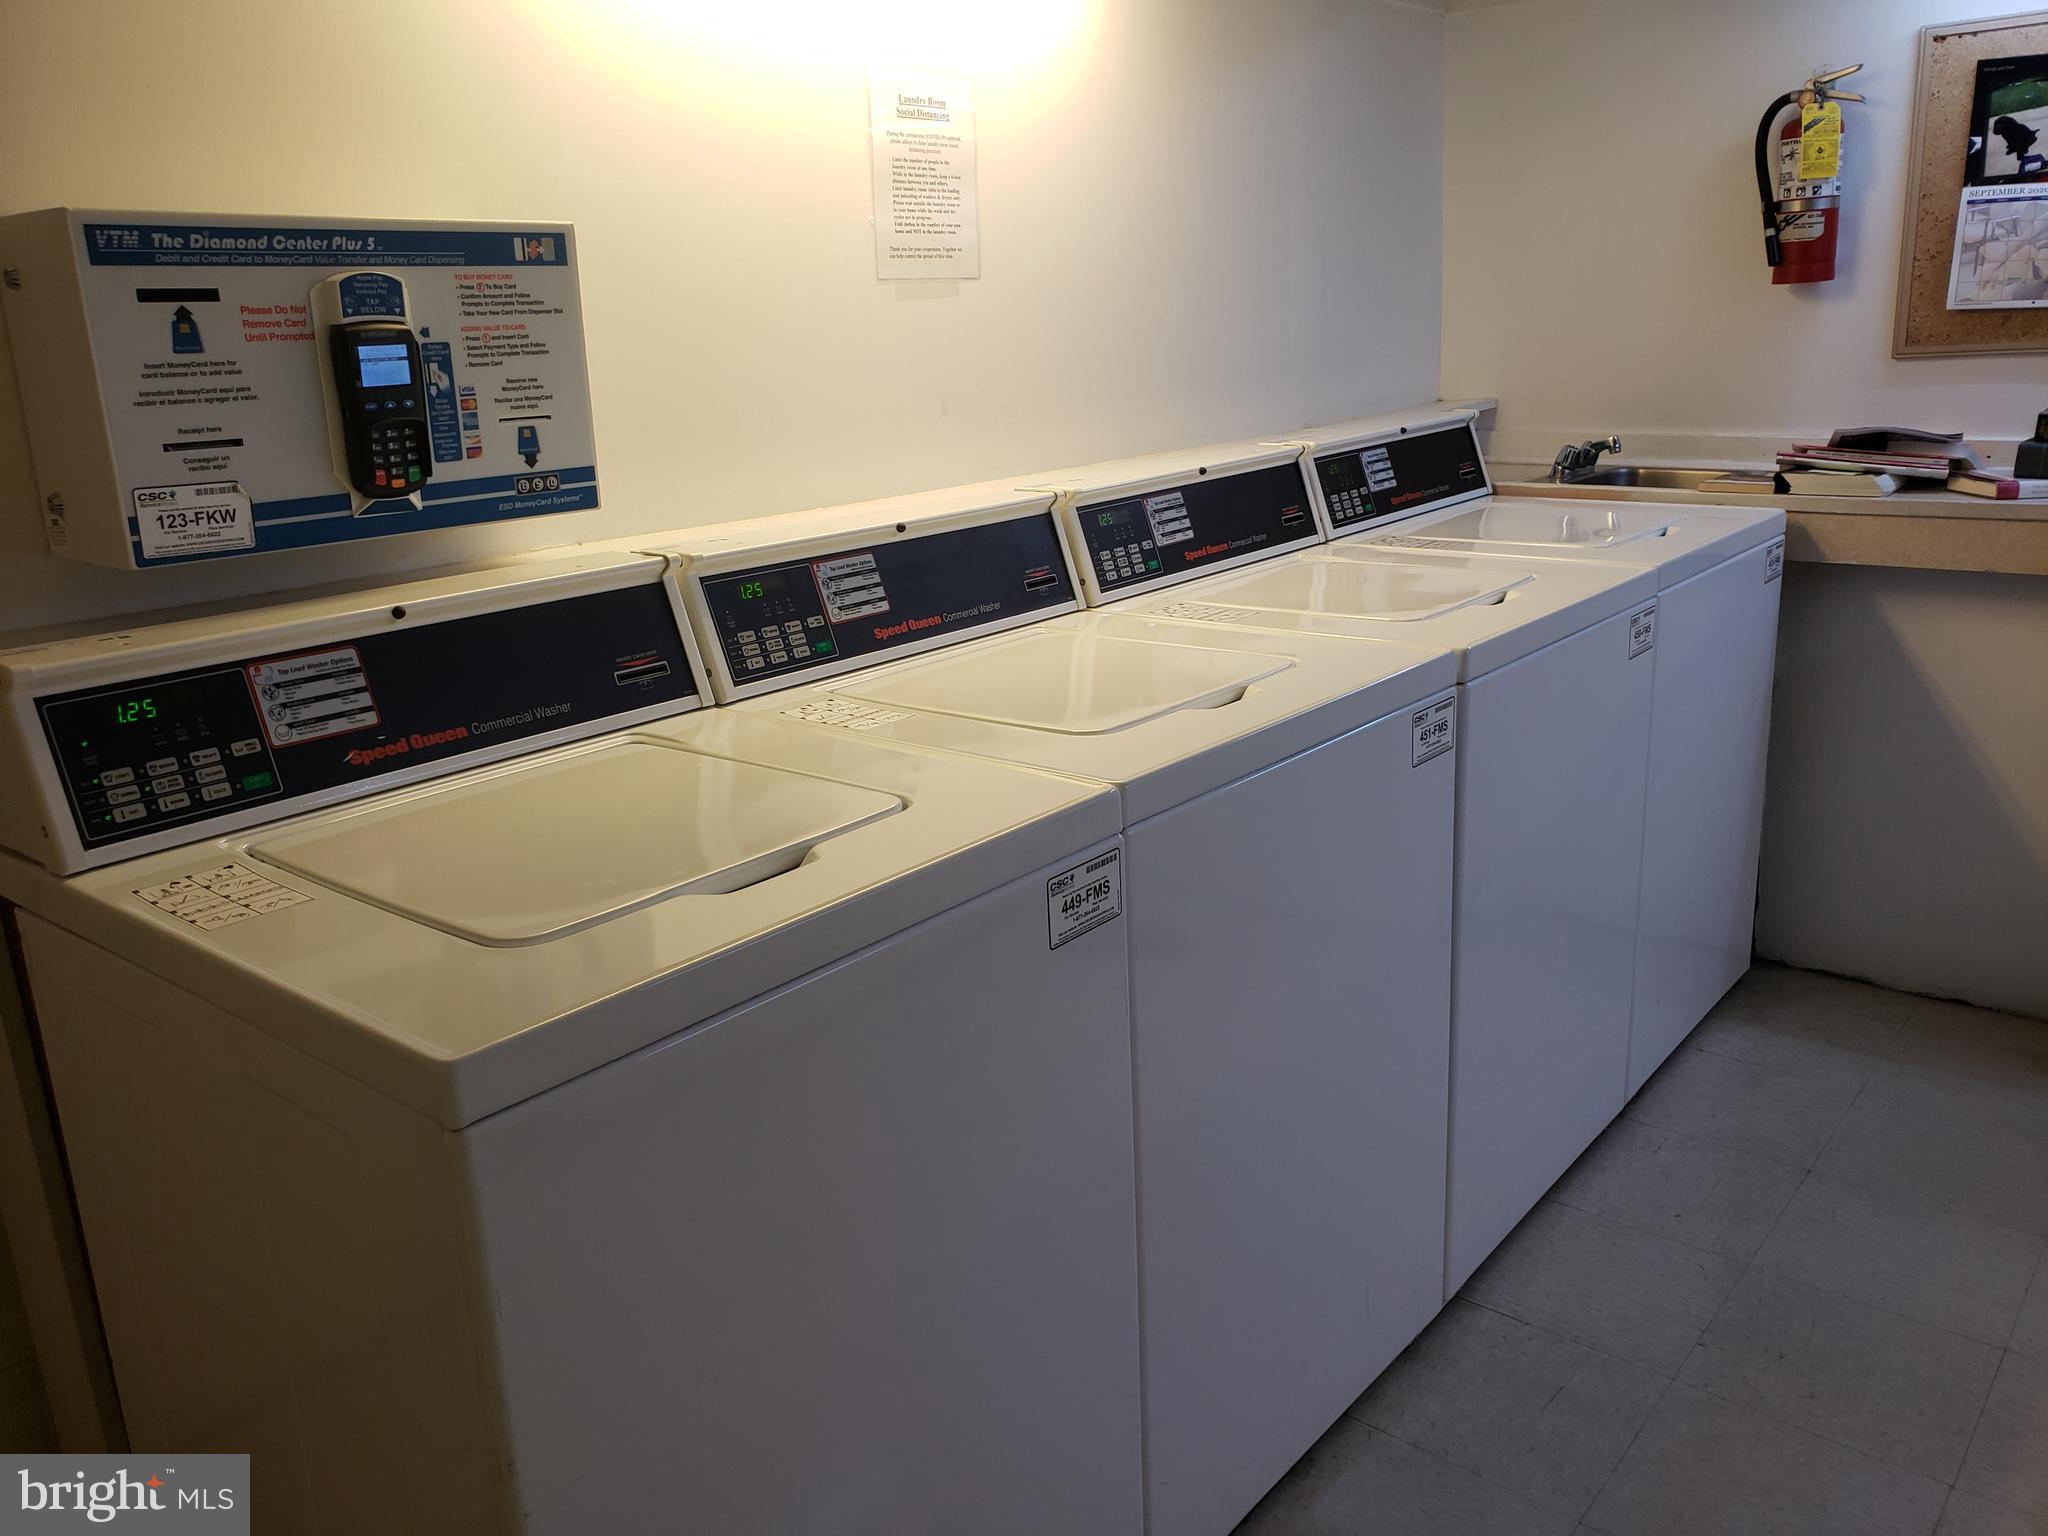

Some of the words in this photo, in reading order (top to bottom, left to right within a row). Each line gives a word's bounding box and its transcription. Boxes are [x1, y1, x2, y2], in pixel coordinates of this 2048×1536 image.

[899, 93, 926, 105] Laundry
[927, 96, 946, 107] Room
[896, 106, 916, 117] Social
[1968, 187, 2026, 198] SEPTEMBER
[95, 230, 139, 248] VTM
[151, 233, 184, 248] The
[189, 231, 267, 250] Diamond
[272, 235, 328, 251] Center
[332, 236, 363, 250] Plus
[155, 254, 181, 263] Debit
[182, 254, 200, 263] and
[202, 254, 230, 264] Credit
[231, 255, 253, 264] Card
[254, 255, 263, 264] to
[264, 255, 313, 265] MoneyCard
[370, 256, 383, 264] and
[384, 256, 408, 265] Money
[409, 256, 427, 265] Card
[240, 305, 273, 315] Please
[274, 305, 288, 314] Do
[290, 304, 307, 314] Not
[242, 319, 282, 329] Remove
[283, 318, 306, 328] Card
[244, 332, 267, 343] Until
[269, 331, 315, 343] Prompted
[167, 361, 208, 370] MoneyCard
[176, 388, 218, 396] MoneyCard
[137, 491, 167, 502] CSC
[498, 502, 513, 511] ESD
[514, 498, 552, 509] MoneyCard
[156, 508, 237, 530] 123-FKW
[1183, 546, 1206, 561] Speed
[1206, 543, 1228, 554] Queen
[873, 622, 909, 640] Speed
[909, 614, 942, 631] Queen
[942, 607, 980, 623] Commercial
[979, 601, 1001, 614] Washer
[278, 668, 289, 676] Top
[290, 665, 306, 673] Load
[306, 661, 329, 670] Washer
[330, 657, 354, 666] Options
[347, 740, 409, 766] Speed
[410, 724, 469, 750] Queen
[470, 709, 534, 736] Commercial
[534, 700, 573, 721] Washer
[1419, 719, 1449, 743] 451-FMS
[1050, 876, 1069, 892] CSC
[1061, 879, 1110, 915] 449-FMS
